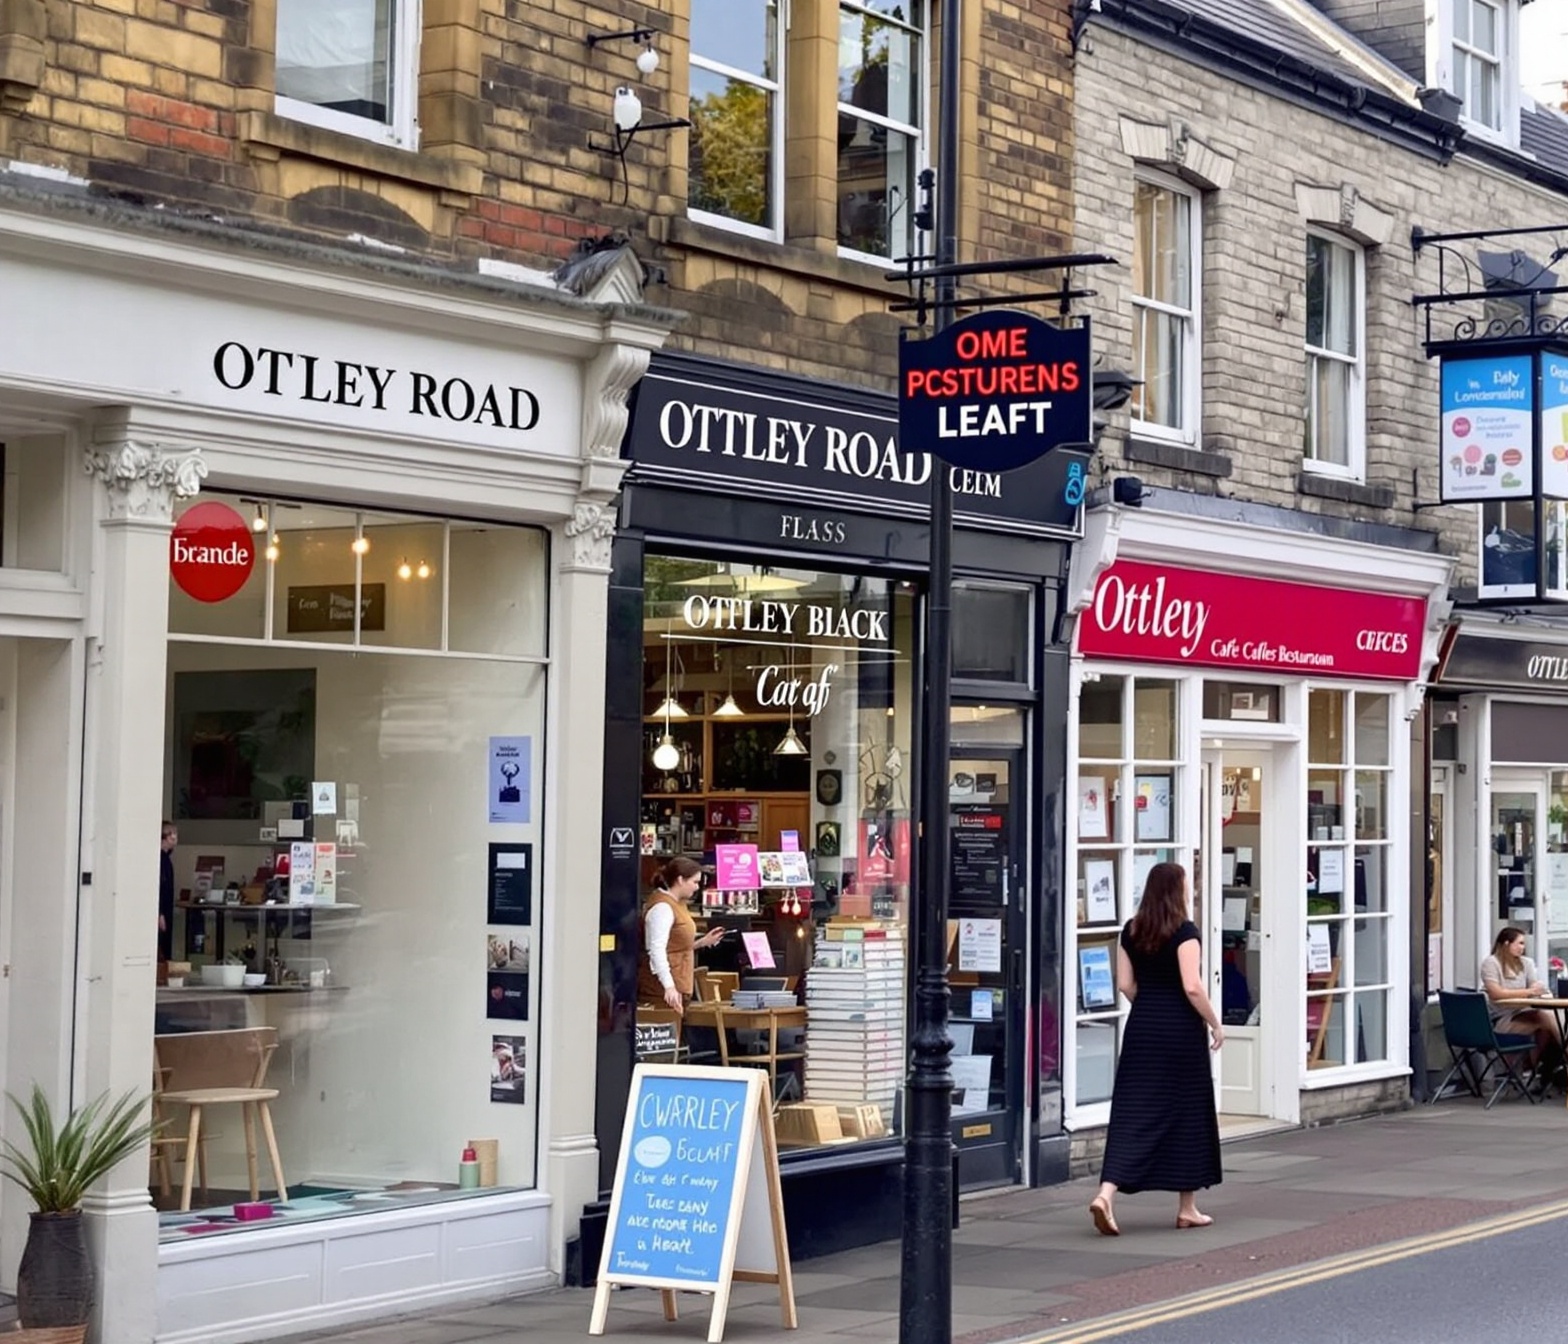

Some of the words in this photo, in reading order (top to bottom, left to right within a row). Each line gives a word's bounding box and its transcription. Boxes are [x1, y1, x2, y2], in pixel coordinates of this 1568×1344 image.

[956, 328, 1028, 360] OME
[213, 341, 397, 410] OTLEY
[408, 371, 540, 431] ROAD
[907, 361, 1080, 398] PCSTURENS
[938, 401, 1053, 438] LEAFT
[659, 400, 817, 468] OTTLEY
[823, 426, 932, 486] ROAD
[779, 514, 847, 544] FLASS
[1095, 575, 1211, 658] Ottley
